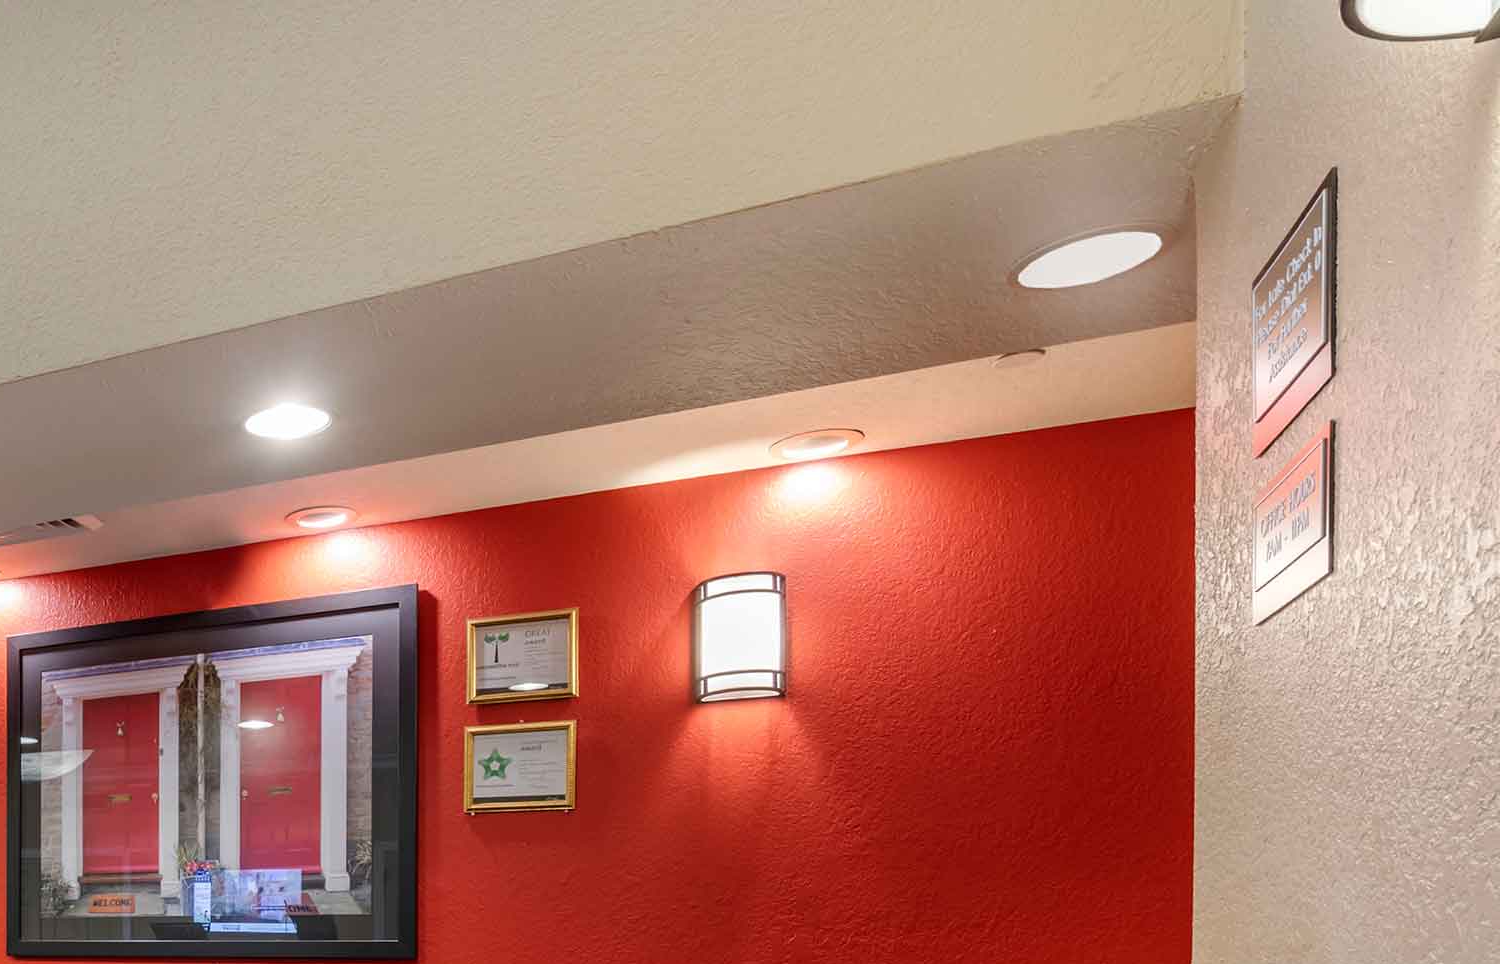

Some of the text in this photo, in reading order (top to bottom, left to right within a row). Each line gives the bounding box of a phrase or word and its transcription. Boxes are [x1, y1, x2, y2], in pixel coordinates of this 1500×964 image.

[1286, 237, 1311, 283] Check
[1256, 310, 1280, 346] Please
[1281, 282, 1298, 316] Dial
[1260, 470, 1316, 539] OFFICE HOURS
